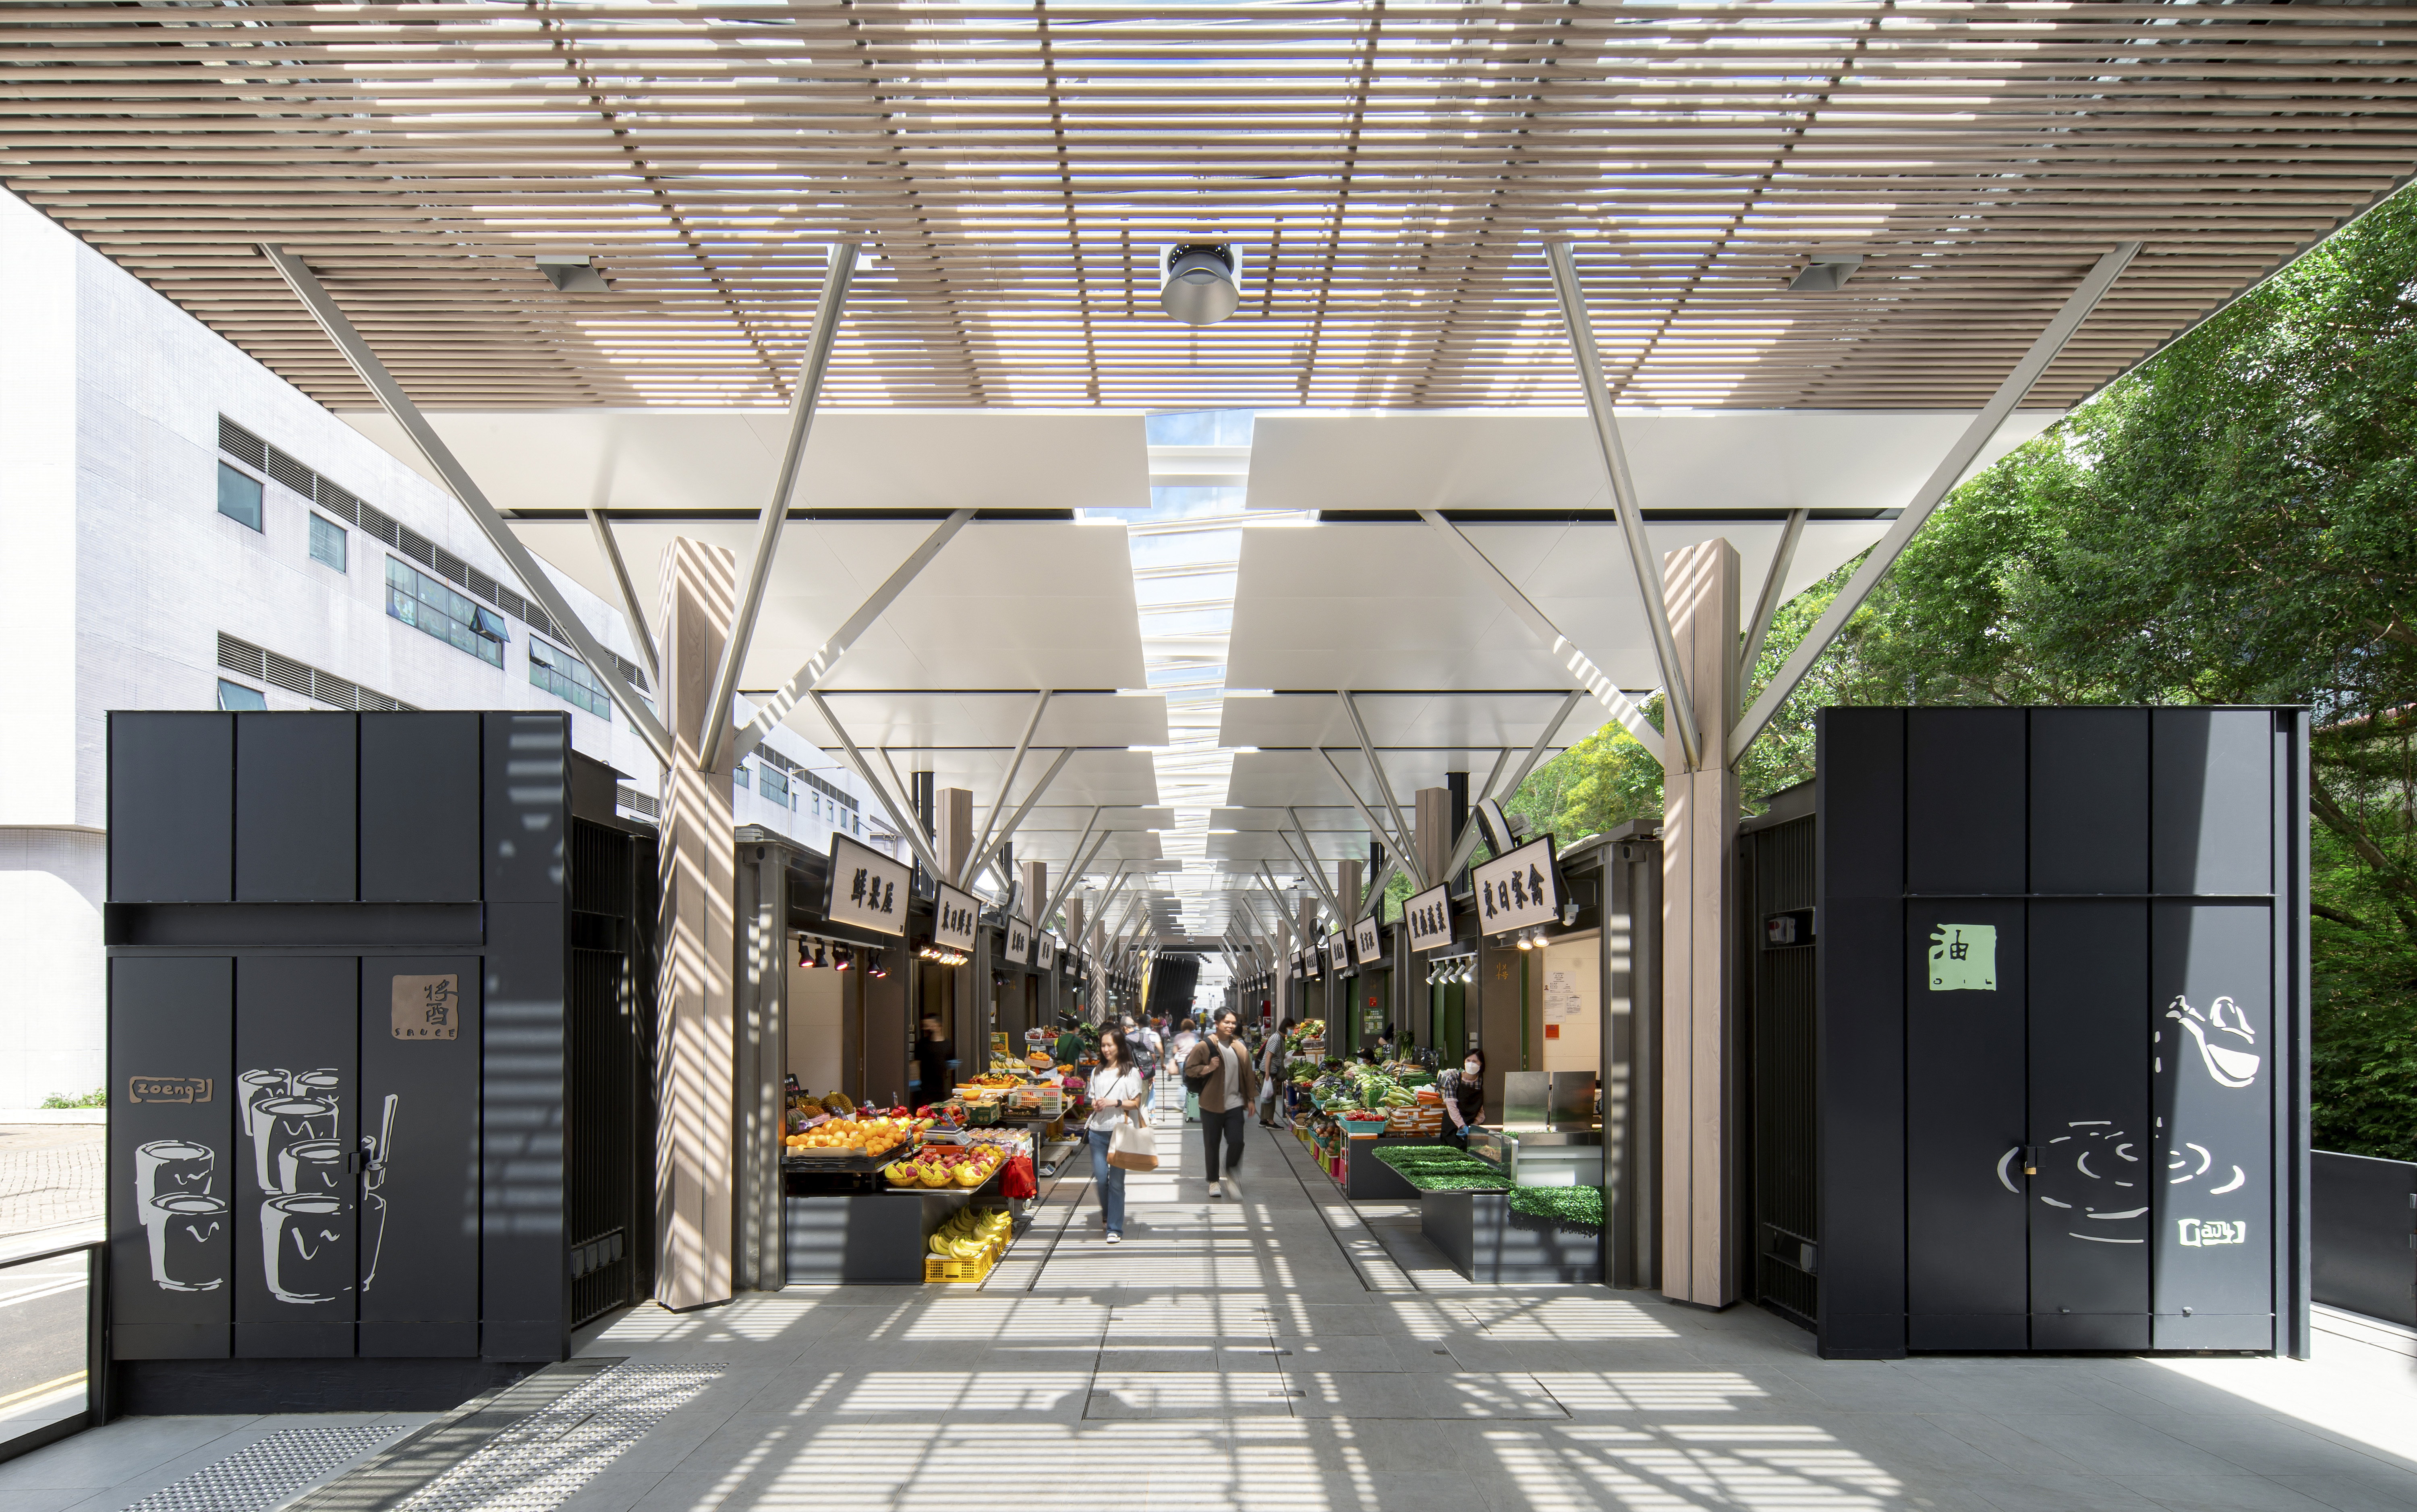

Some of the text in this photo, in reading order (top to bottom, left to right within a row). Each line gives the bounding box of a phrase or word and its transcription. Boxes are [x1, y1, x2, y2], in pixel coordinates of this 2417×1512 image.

[851, 868, 894, 914] 鮮果屋
[1483, 863, 1544, 920] 東日家禽
[395, 1028, 456, 1037] SAUCE
